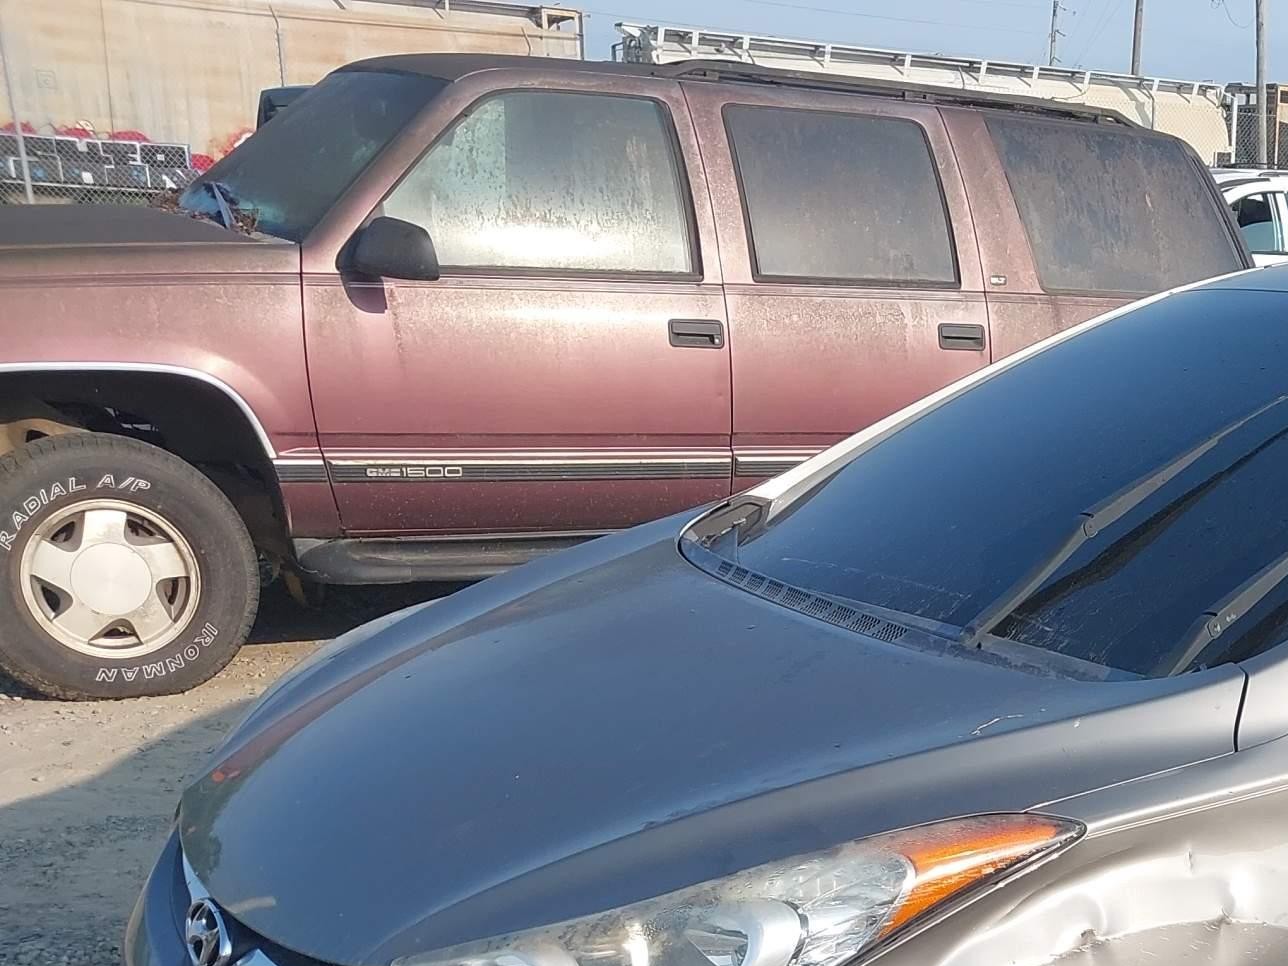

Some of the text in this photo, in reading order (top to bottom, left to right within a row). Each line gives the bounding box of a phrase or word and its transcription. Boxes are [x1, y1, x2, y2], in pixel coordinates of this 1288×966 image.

[402, 466, 463, 477] 1500
[0, 474, 151, 550] RADIAL A/P
[96, 622, 219, 682] IRONMAN
